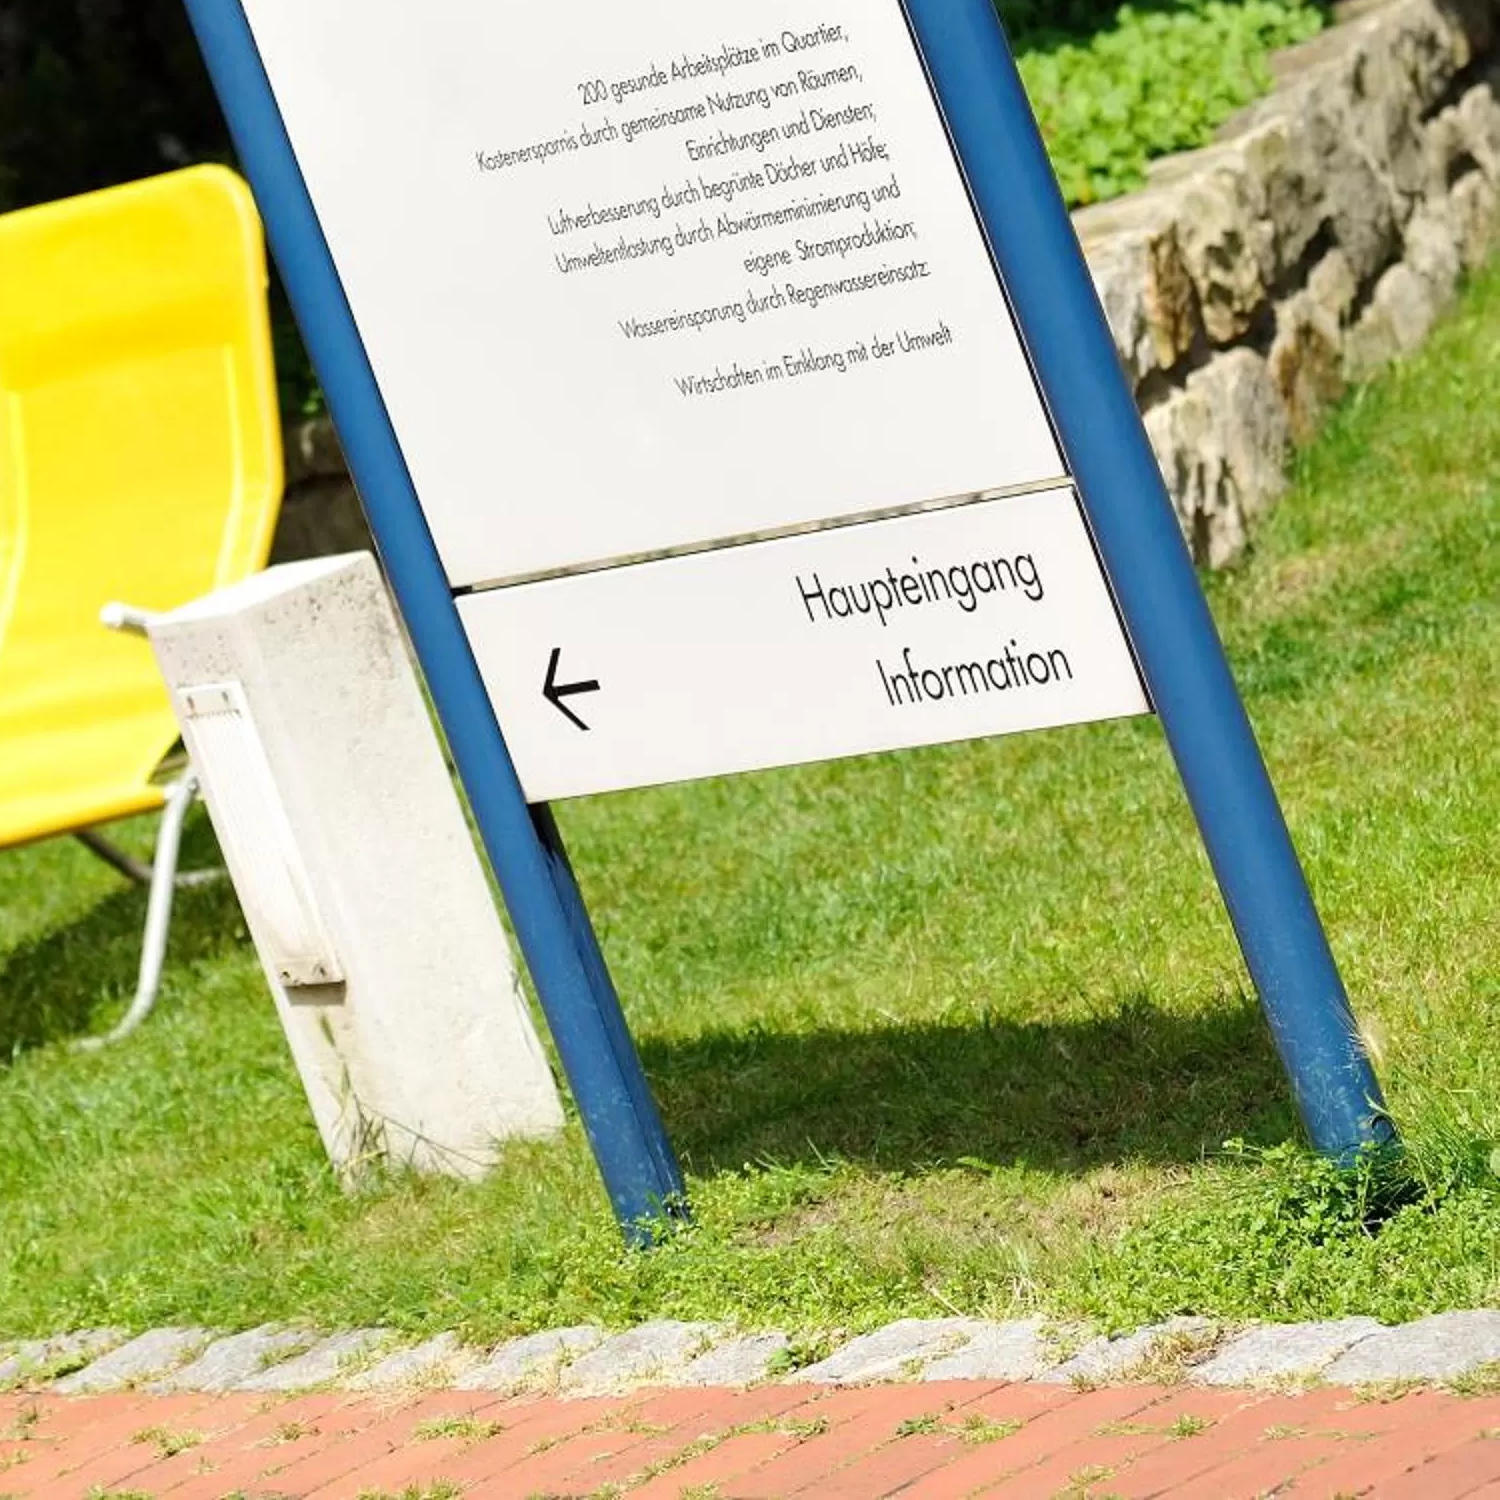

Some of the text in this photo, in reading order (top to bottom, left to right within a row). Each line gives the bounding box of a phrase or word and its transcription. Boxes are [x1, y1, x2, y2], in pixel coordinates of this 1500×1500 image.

[577, 78, 609, 106] 200
[609, 64, 669, 104] gesunde
[671, 43, 761, 81] Arbeitsplätze
[758, 38, 781, 59] im
[475, 130, 579, 171] Kostenersparnis
[579, 117, 619, 147] durch
[621, 103, 707, 143] gemeinsame
[705, 88, 771, 115] Nutzung
[769, 80, 799, 98] von
[685, 127, 781, 162] Einrichtungen
[781, 110, 811, 140] und
[547, 197, 661, 236] Luftverbesserung
[661, 179, 701, 209] durch
[697, 171, 765, 203] begrünte
[763, 154, 817, 185] Dächer
[819, 142, 849, 173] und
[555, 173, 901, 274] Umweltentlastung durch Abwärmeminimierung und
[743, 250, 793, 277] eigene
[617, 303, 747, 339] Wassereinsparung
[745, 283, 787, 315] durch
[673, 320, 953, 397] Wirtschaften im Einklang mit der Umwelt
[795, 553, 1045, 628] Haupteingang
[875, 638, 1074, 707] Information
